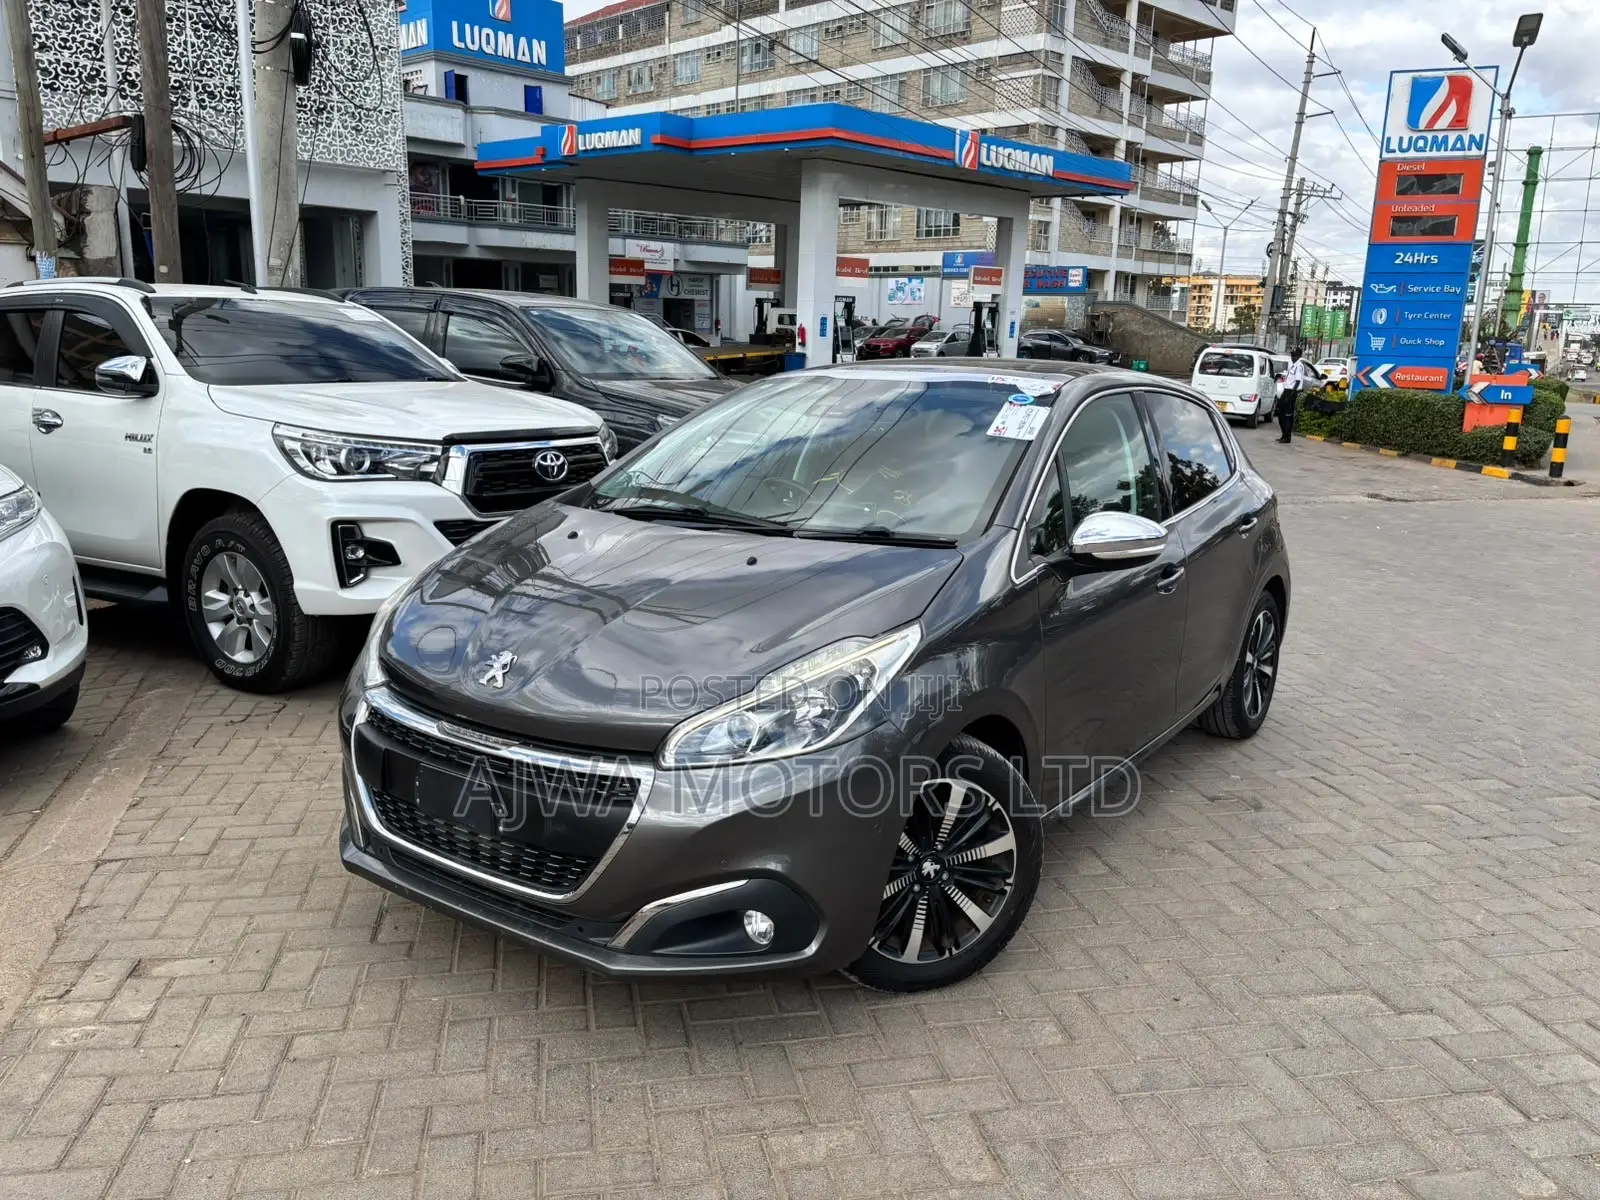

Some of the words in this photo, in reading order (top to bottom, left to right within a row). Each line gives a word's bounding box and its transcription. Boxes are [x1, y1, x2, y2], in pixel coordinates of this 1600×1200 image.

[452, 21, 547, 66] LUQMAN
[578, 128, 641, 150] LUQMAN
[1385, 133, 1485, 153] LUQMAN
[980, 143, 1053, 176] LUQMAN
[1397, 162, 1425, 171] Diesel
[1391, 204, 1435, 212] Unleaded
[1394, 252, 1439, 264] 24Hrs
[1407, 284, 1441, 293] Service
[1443, 284, 1461, 294] Bay
[1404, 311, 1422, 320] Tyre
[1424, 311, 1452, 320] Center
[1424, 337, 1445, 346] Shop
[1395, 372, 1444, 382] Restaurant
[1500, 389, 1512, 400] In
[187, 544, 211, 612] BRAVO
